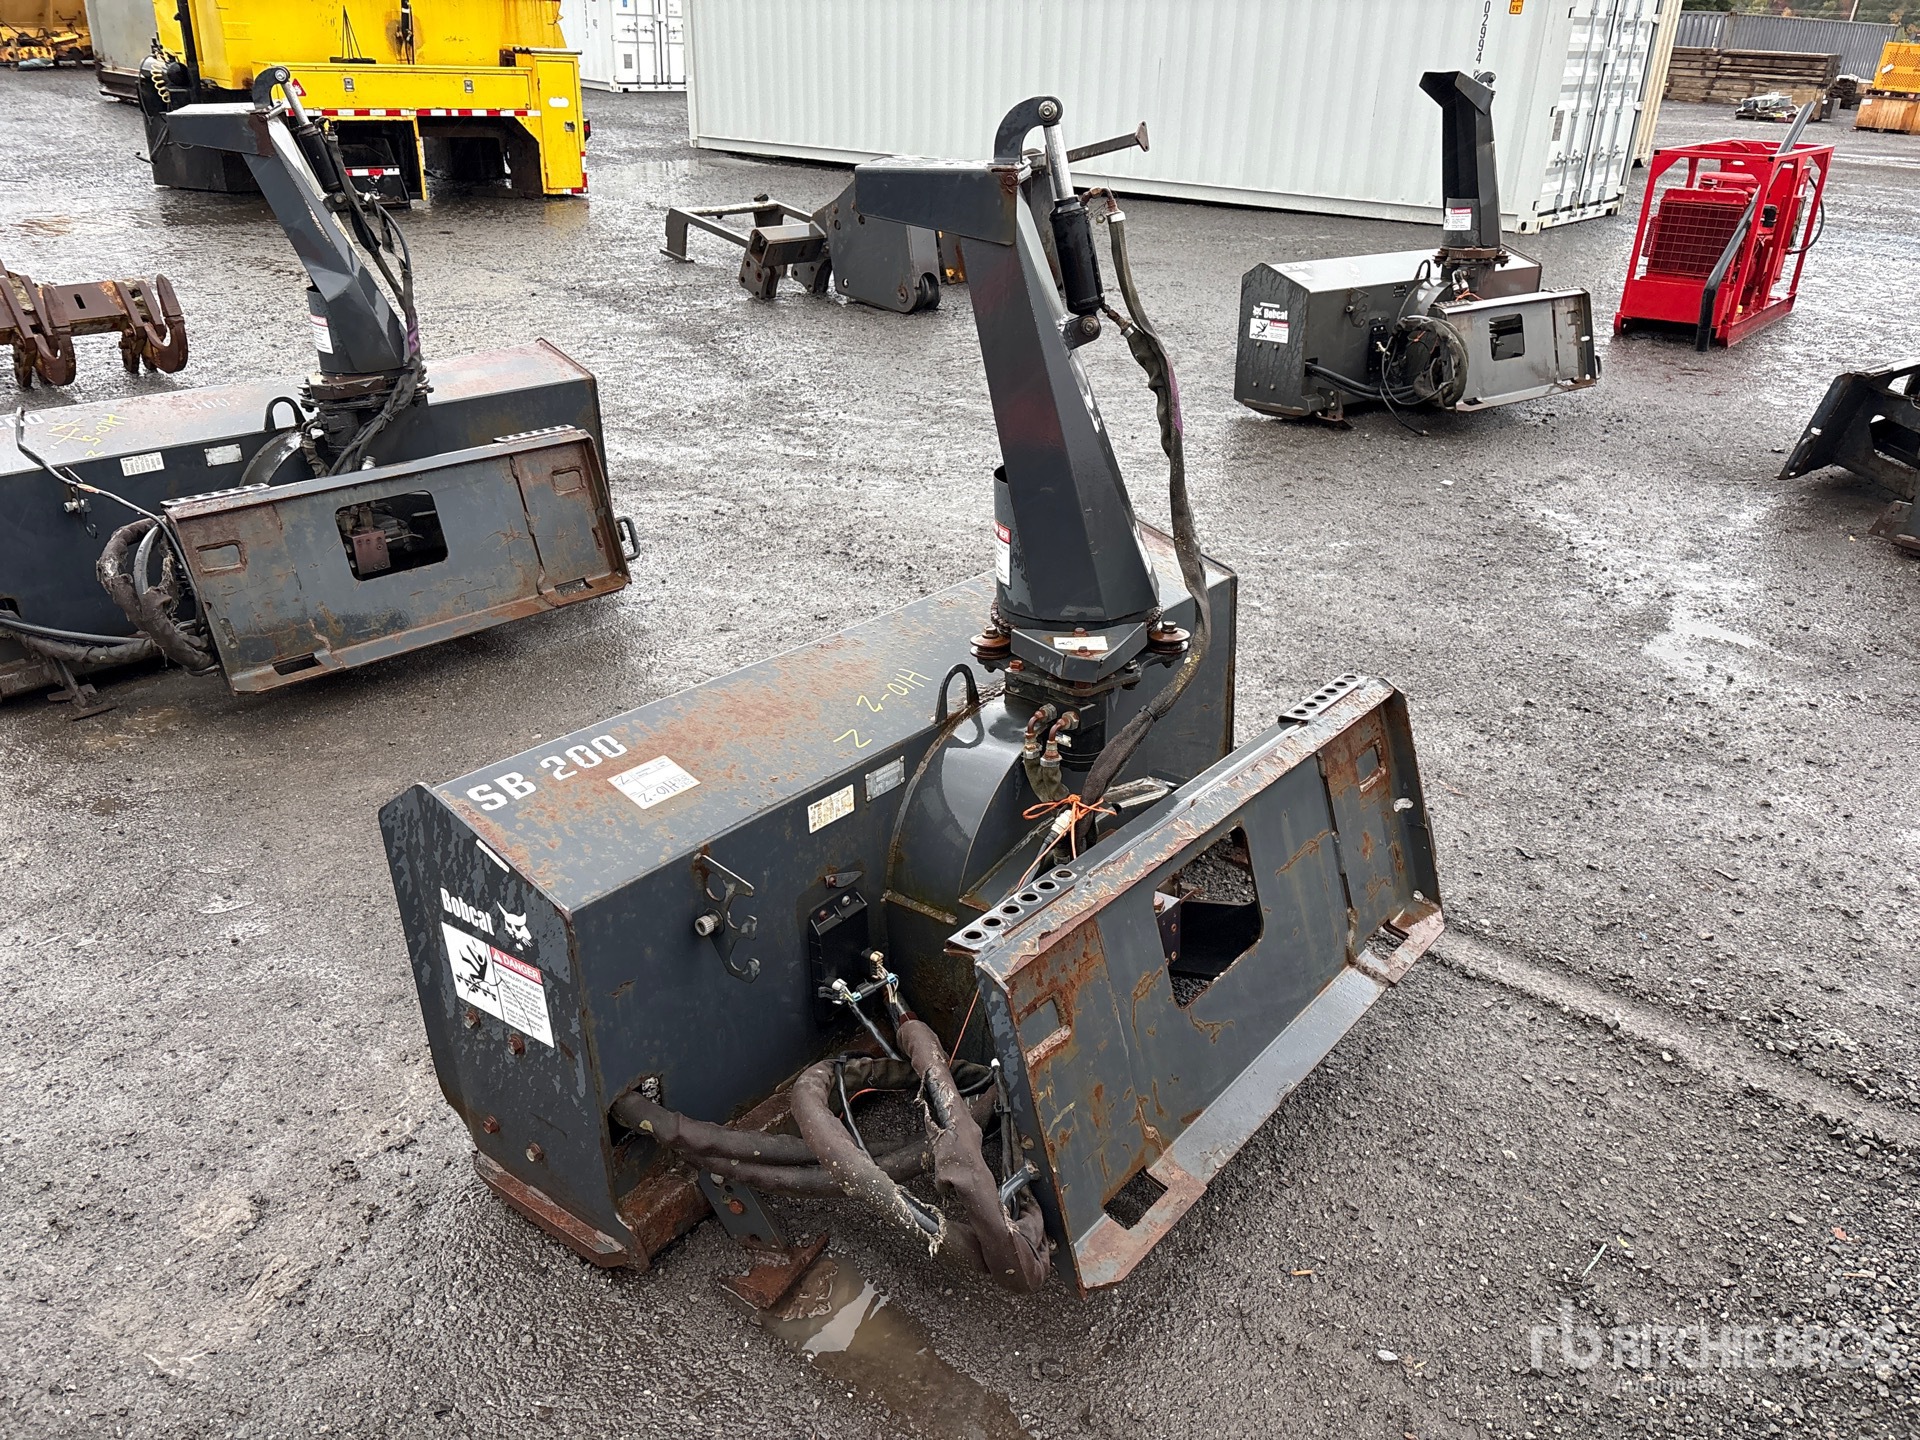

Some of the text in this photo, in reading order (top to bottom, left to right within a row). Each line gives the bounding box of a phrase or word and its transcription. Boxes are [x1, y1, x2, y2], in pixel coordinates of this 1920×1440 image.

[1475, 0, 1491, 64] 02994
[1263, 308, 1288, 320] Bobcat
[466, 734, 628, 811] SB 200
[440, 887, 495, 936] Bobcat
[502, 956, 539, 980] DANGER
